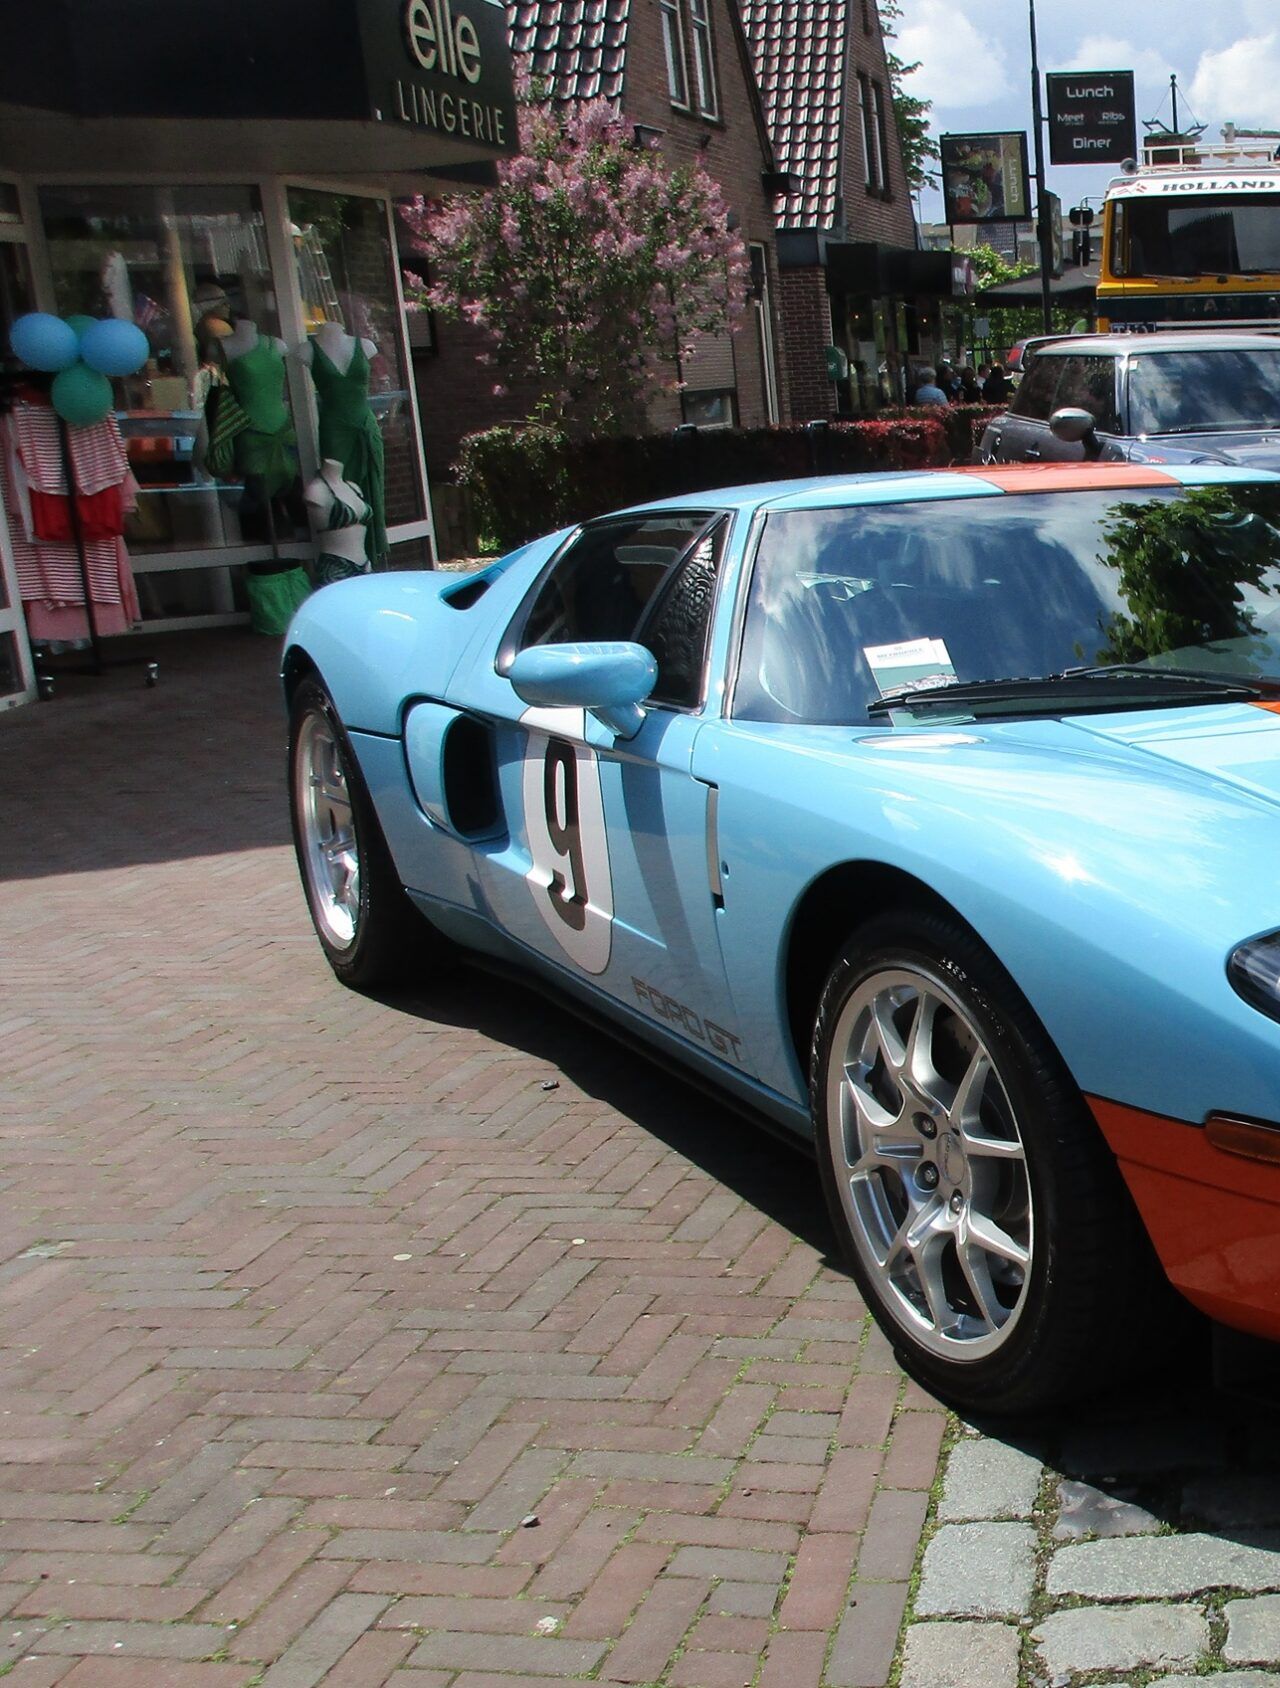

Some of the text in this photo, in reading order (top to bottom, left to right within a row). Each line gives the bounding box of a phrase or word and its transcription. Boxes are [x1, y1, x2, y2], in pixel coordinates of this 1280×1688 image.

[405, 0, 482, 84] elle
[1066, 85, 1115, 99] Lunch
[396, 79, 507, 146] LINGERIE
[1057, 113, 1085, 123] Meet
[1102, 112, 1126, 121] Ribs
[1072, 136, 1112, 149] Diner
[1161, 180, 1276, 192] HOLLAND
[543, 736, 589, 932] 9
[630, 975, 743, 1063] FORD GT
